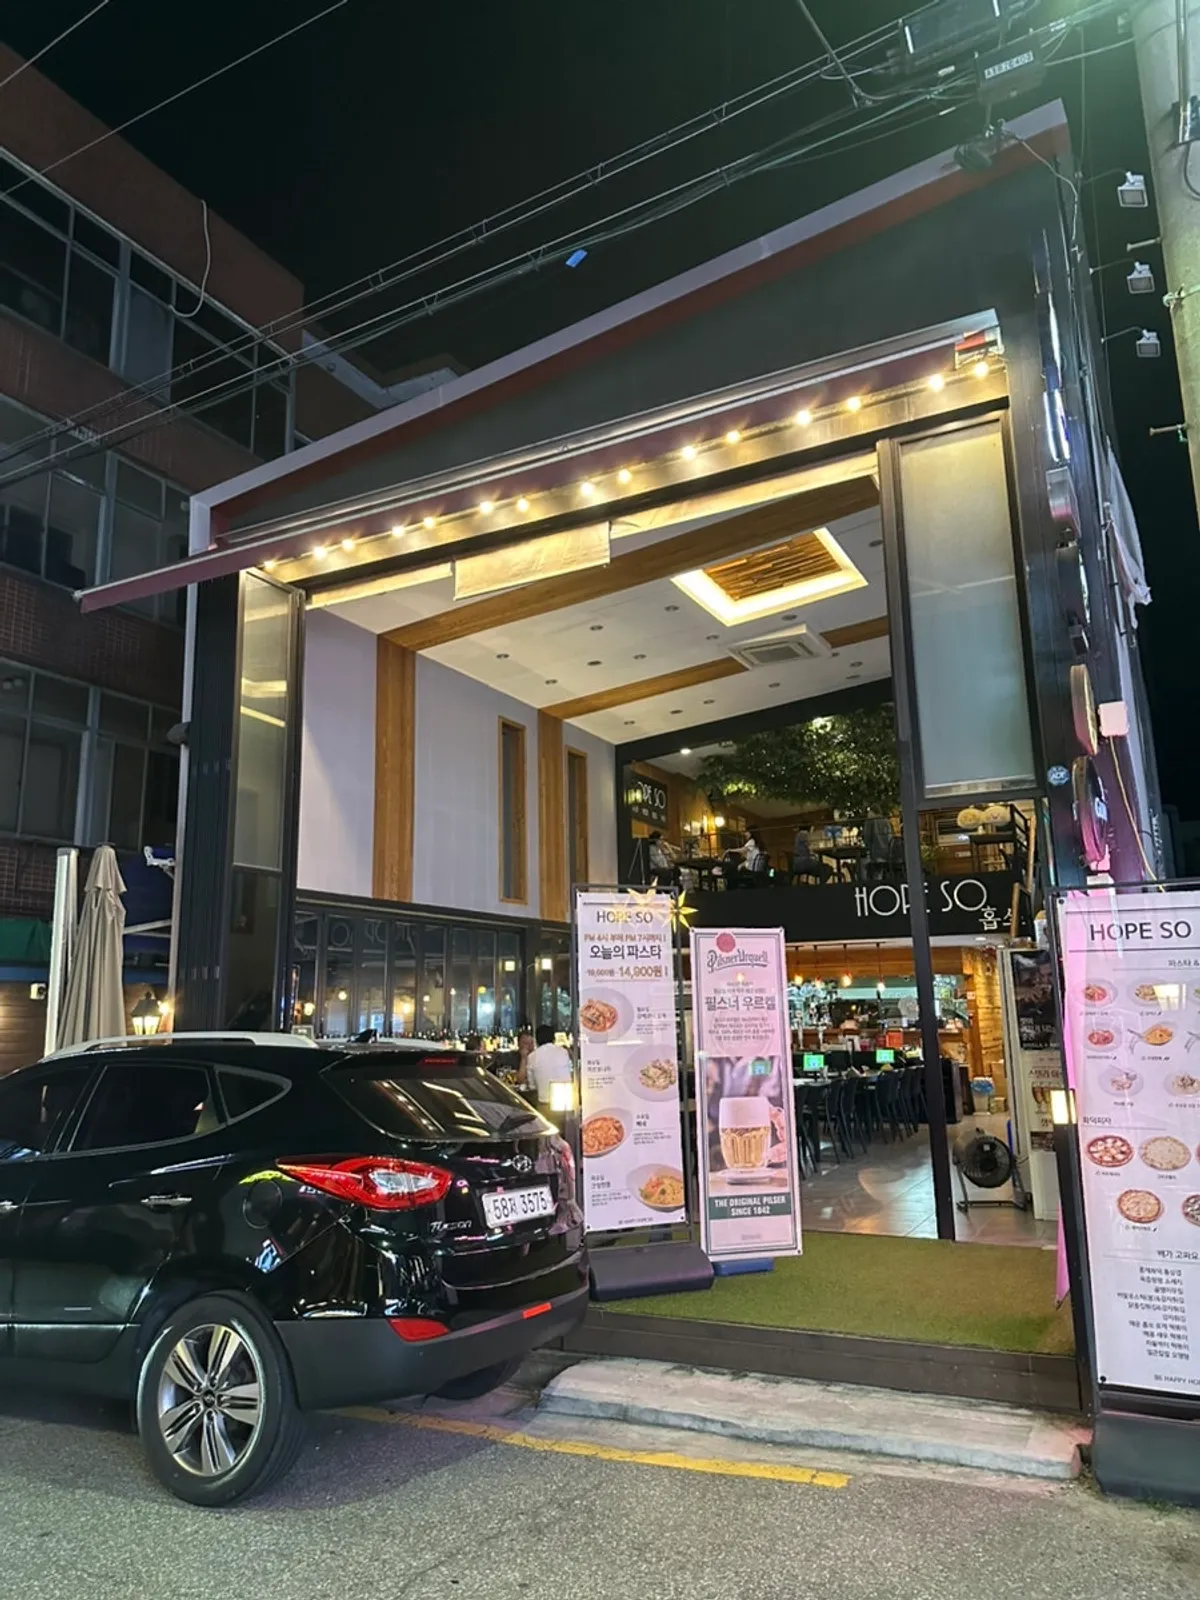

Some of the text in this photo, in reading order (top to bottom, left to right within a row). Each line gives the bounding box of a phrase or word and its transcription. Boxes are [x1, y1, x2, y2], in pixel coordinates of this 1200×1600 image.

[854, 879, 988, 917] HOP SO
[635, 911, 653, 923] SO
[1089, 920, 1192, 941] HOPE SO
[589, 944, 662, 960] 오늘의 파스타
[705, 995, 740, 1012] 필스너
[519, 1191, 548, 1214] 3575
[714, 1198, 728, 1208] THE
[729, 1196, 761, 1207] ORIGINAL
[731, 1206, 771, 1216] SINCE 1842
